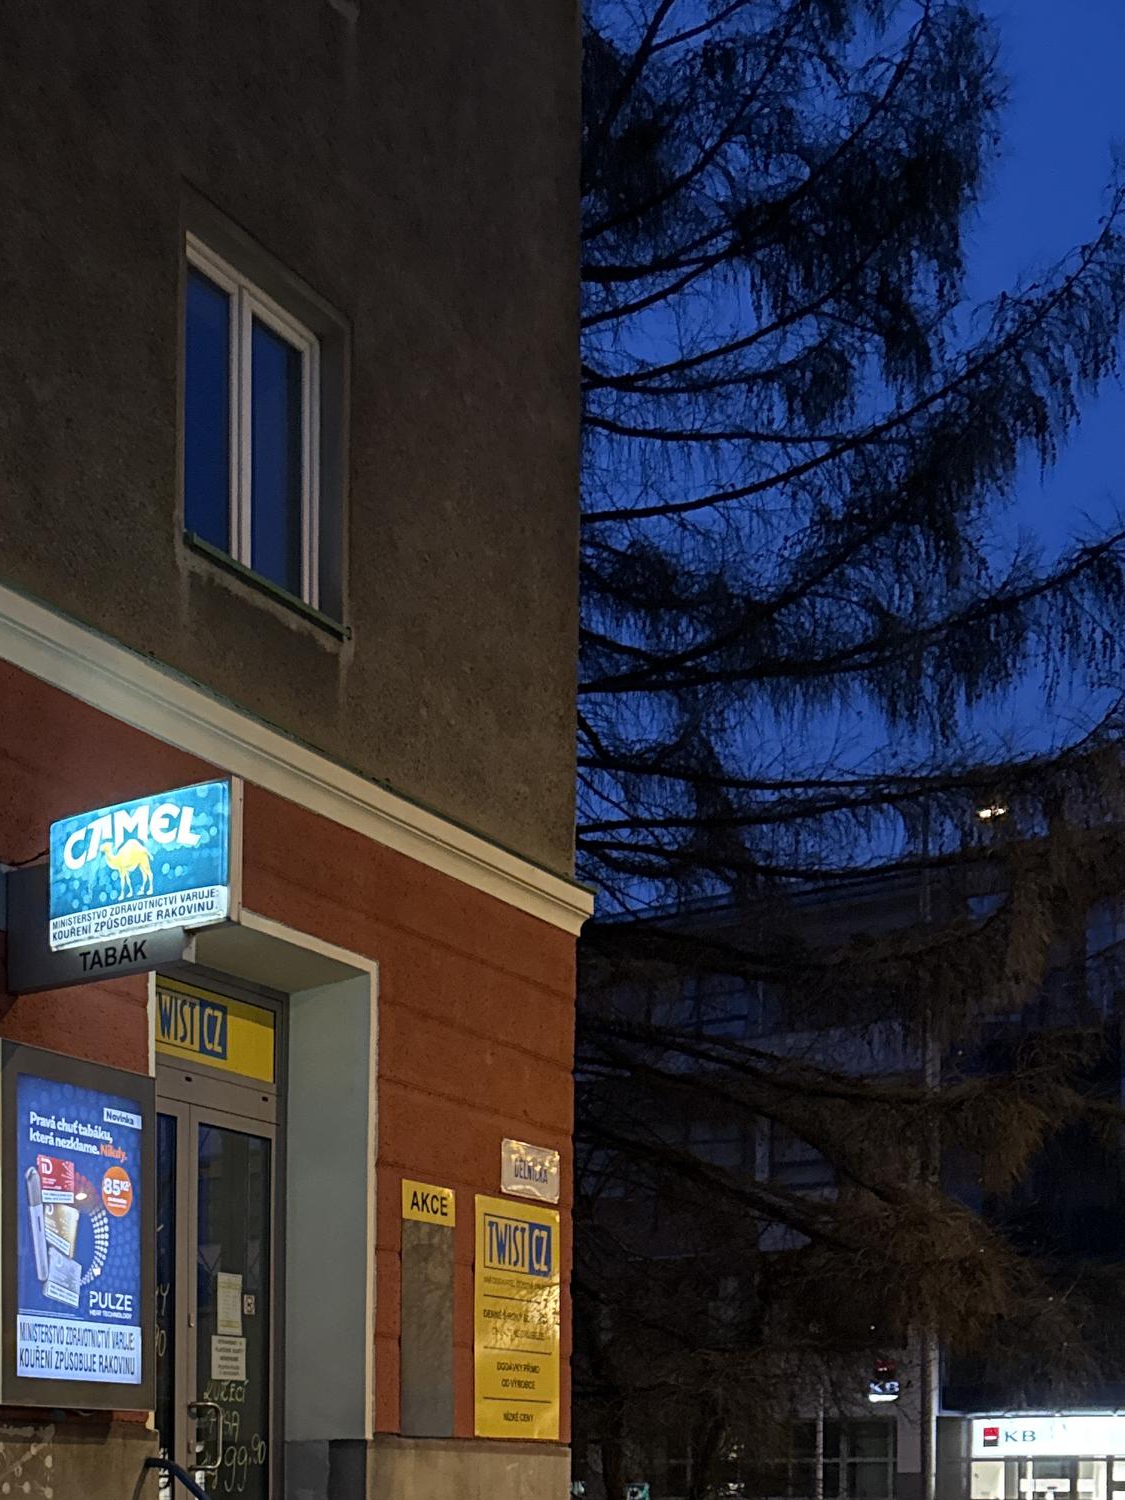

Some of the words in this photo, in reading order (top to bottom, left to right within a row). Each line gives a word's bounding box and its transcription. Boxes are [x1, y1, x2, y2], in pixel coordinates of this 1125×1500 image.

[63, 803, 203, 871] CAMEL
[52, 908, 107, 930] MINISTERSTVO
[52, 922, 92, 942] KOUŘENÍ
[94, 911, 153, 933] ZPŮSOBUJE
[79, 939, 148, 972] TABÁK
[156, 992, 196, 1045] WIST
[204, 1006, 223, 1054] CZ
[29, 1111, 56, 1129] Pravá
[57, 1117, 78, 1135] chuť
[78, 1124, 114, 1144] tabáku,
[106, 1110, 135, 1126] Novinka
[29, 1127, 55, 1146] která
[55, 1136, 100, 1155] nezklame.
[410, 1190, 449, 1217] AKCE
[488, 1220, 527, 1268] TWIST
[532, 1228, 548, 1272] CZ
[89, 1290, 133, 1312] PULZE
[19, 1345, 53, 1369] KOUŘENÍ
[54, 1347, 97, 1373] ZPŮSOBUJE
[98, 1354, 135, 1376] RAKOVINU
[868, 1380, 900, 1394] KB
[1004, 1430, 1037, 1443] KB
